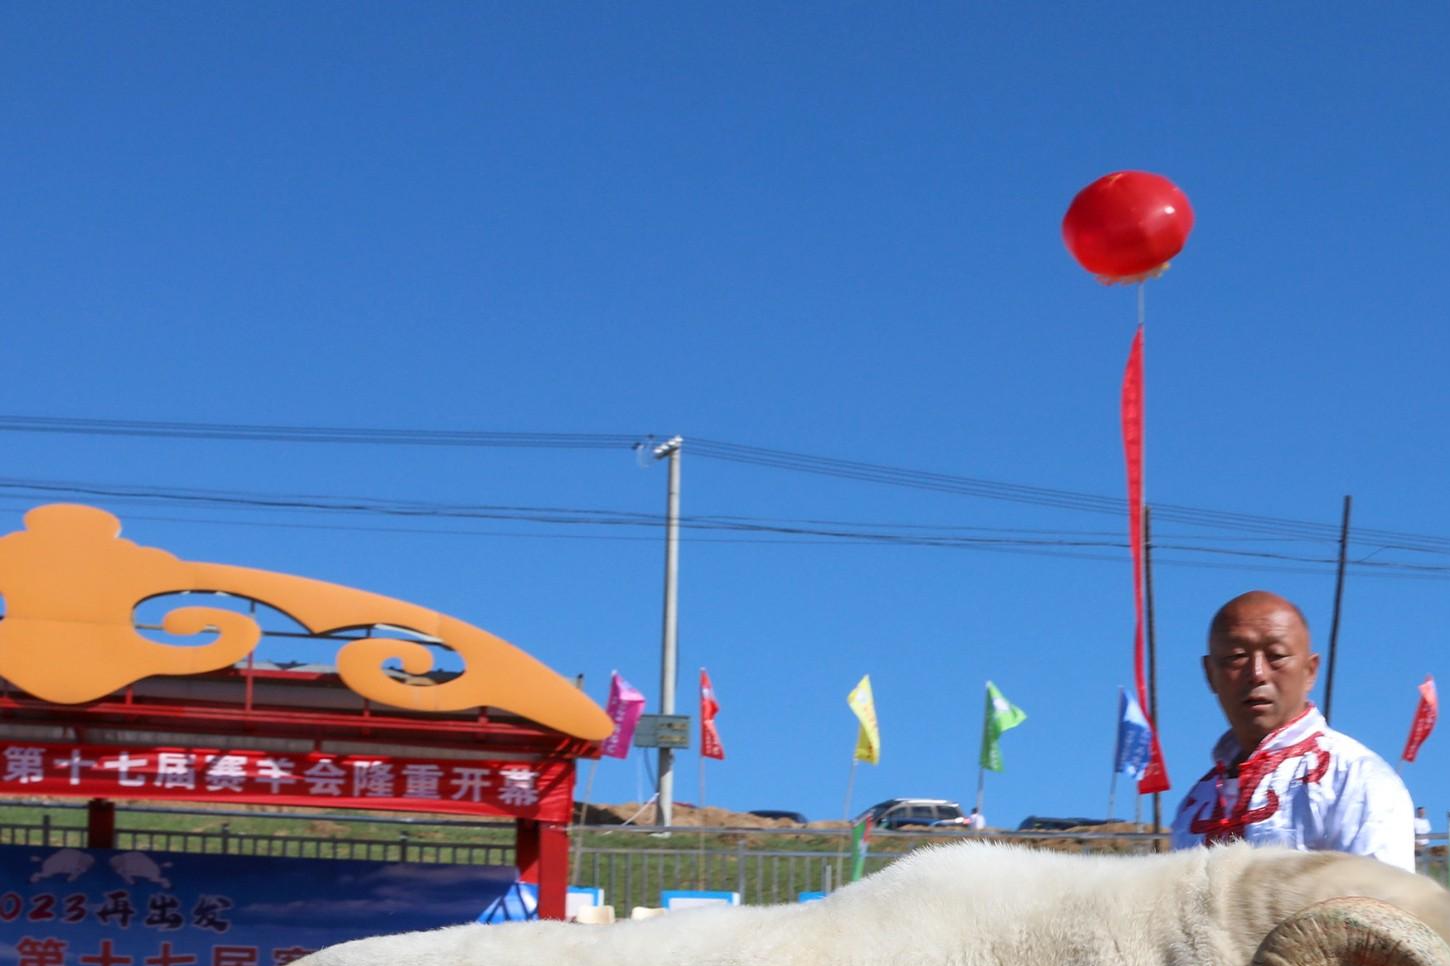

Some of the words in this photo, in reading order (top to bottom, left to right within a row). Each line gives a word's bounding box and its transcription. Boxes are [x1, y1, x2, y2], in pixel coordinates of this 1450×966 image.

[4, 746, 540, 806] 第十七届赛羊会隆重开幕
